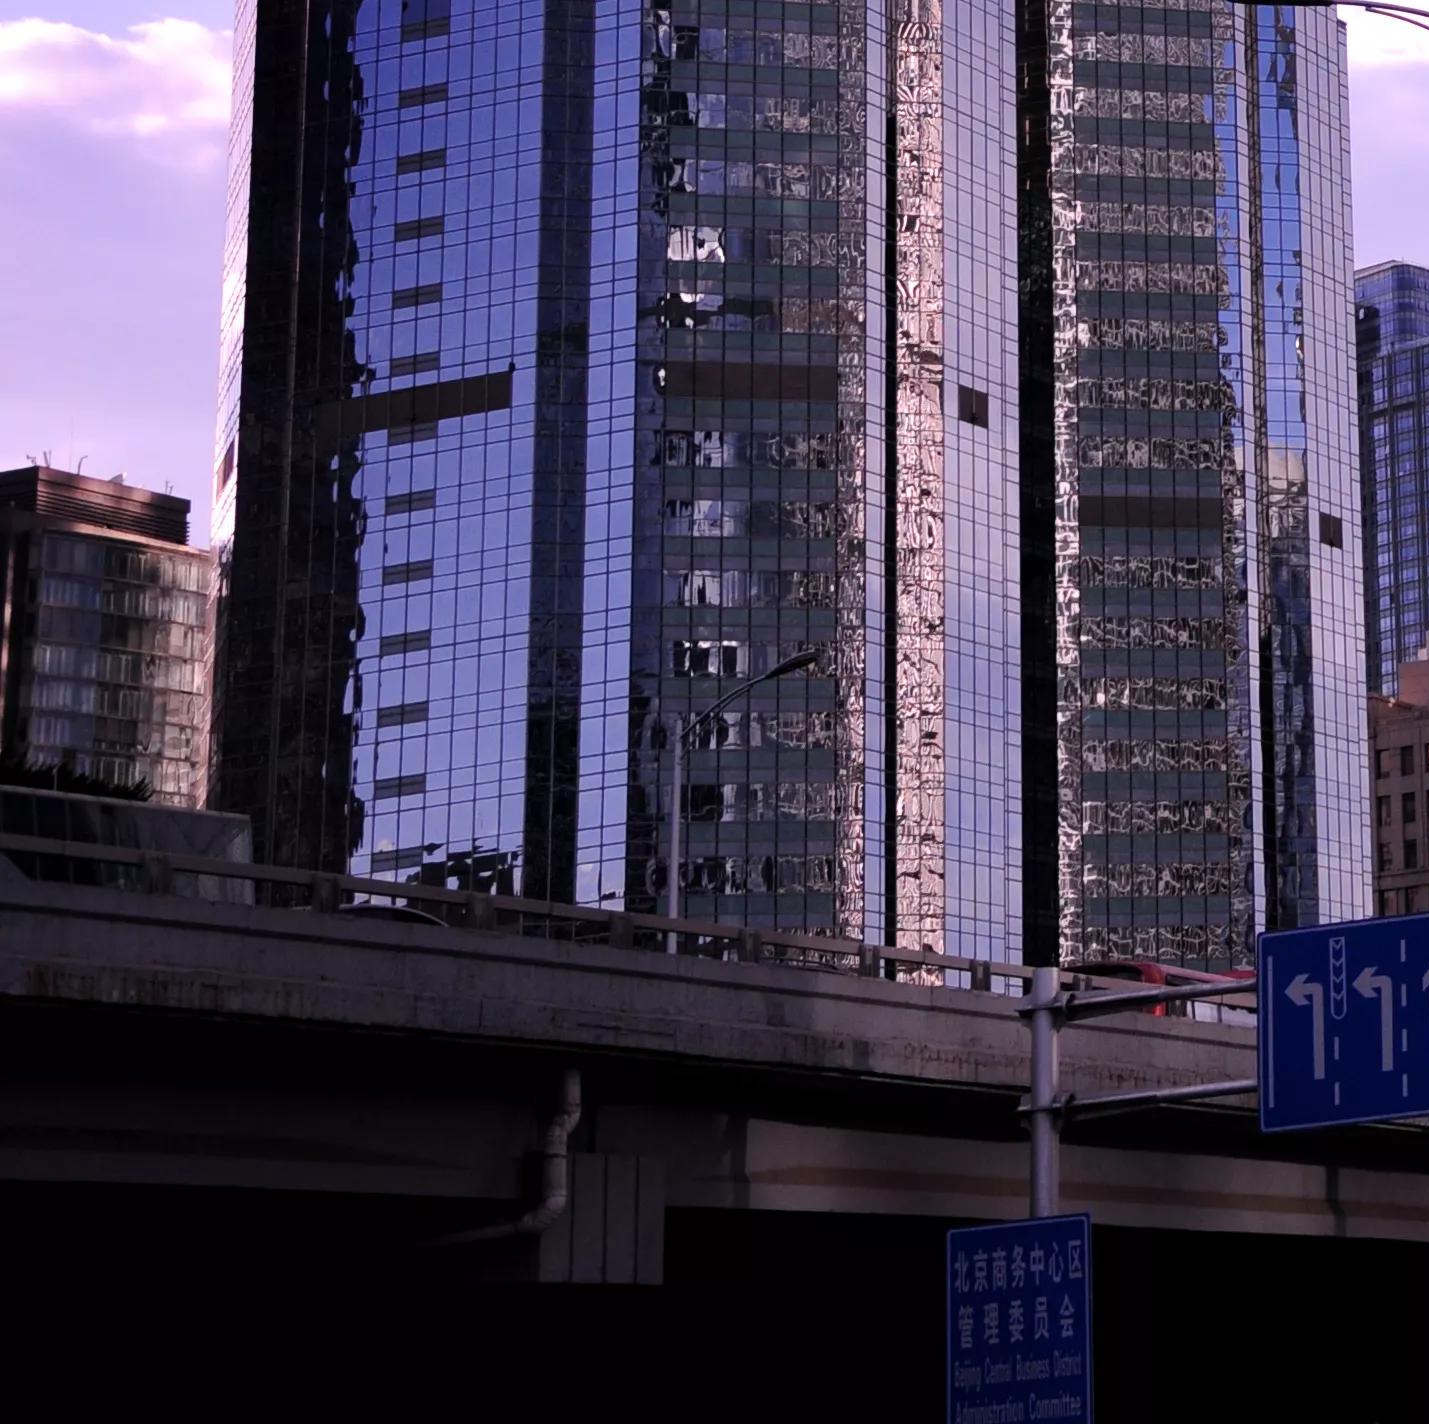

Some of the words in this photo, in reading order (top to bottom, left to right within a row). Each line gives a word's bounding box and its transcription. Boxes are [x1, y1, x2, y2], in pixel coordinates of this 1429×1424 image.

[953, 1239, 1083, 1293] 北京商务中心区
[957, 1292, 1076, 1349] 管理委员会
[953, 1361, 982, 1392] Beijing
[984, 1356, 1012, 1384] Central
[1016, 1353, 1051, 1381] Business
[1053, 1349, 1082, 1377] District
[955, 1394, 1025, 1424] Administration
[1029, 1390, 1082, 1421] Committee
